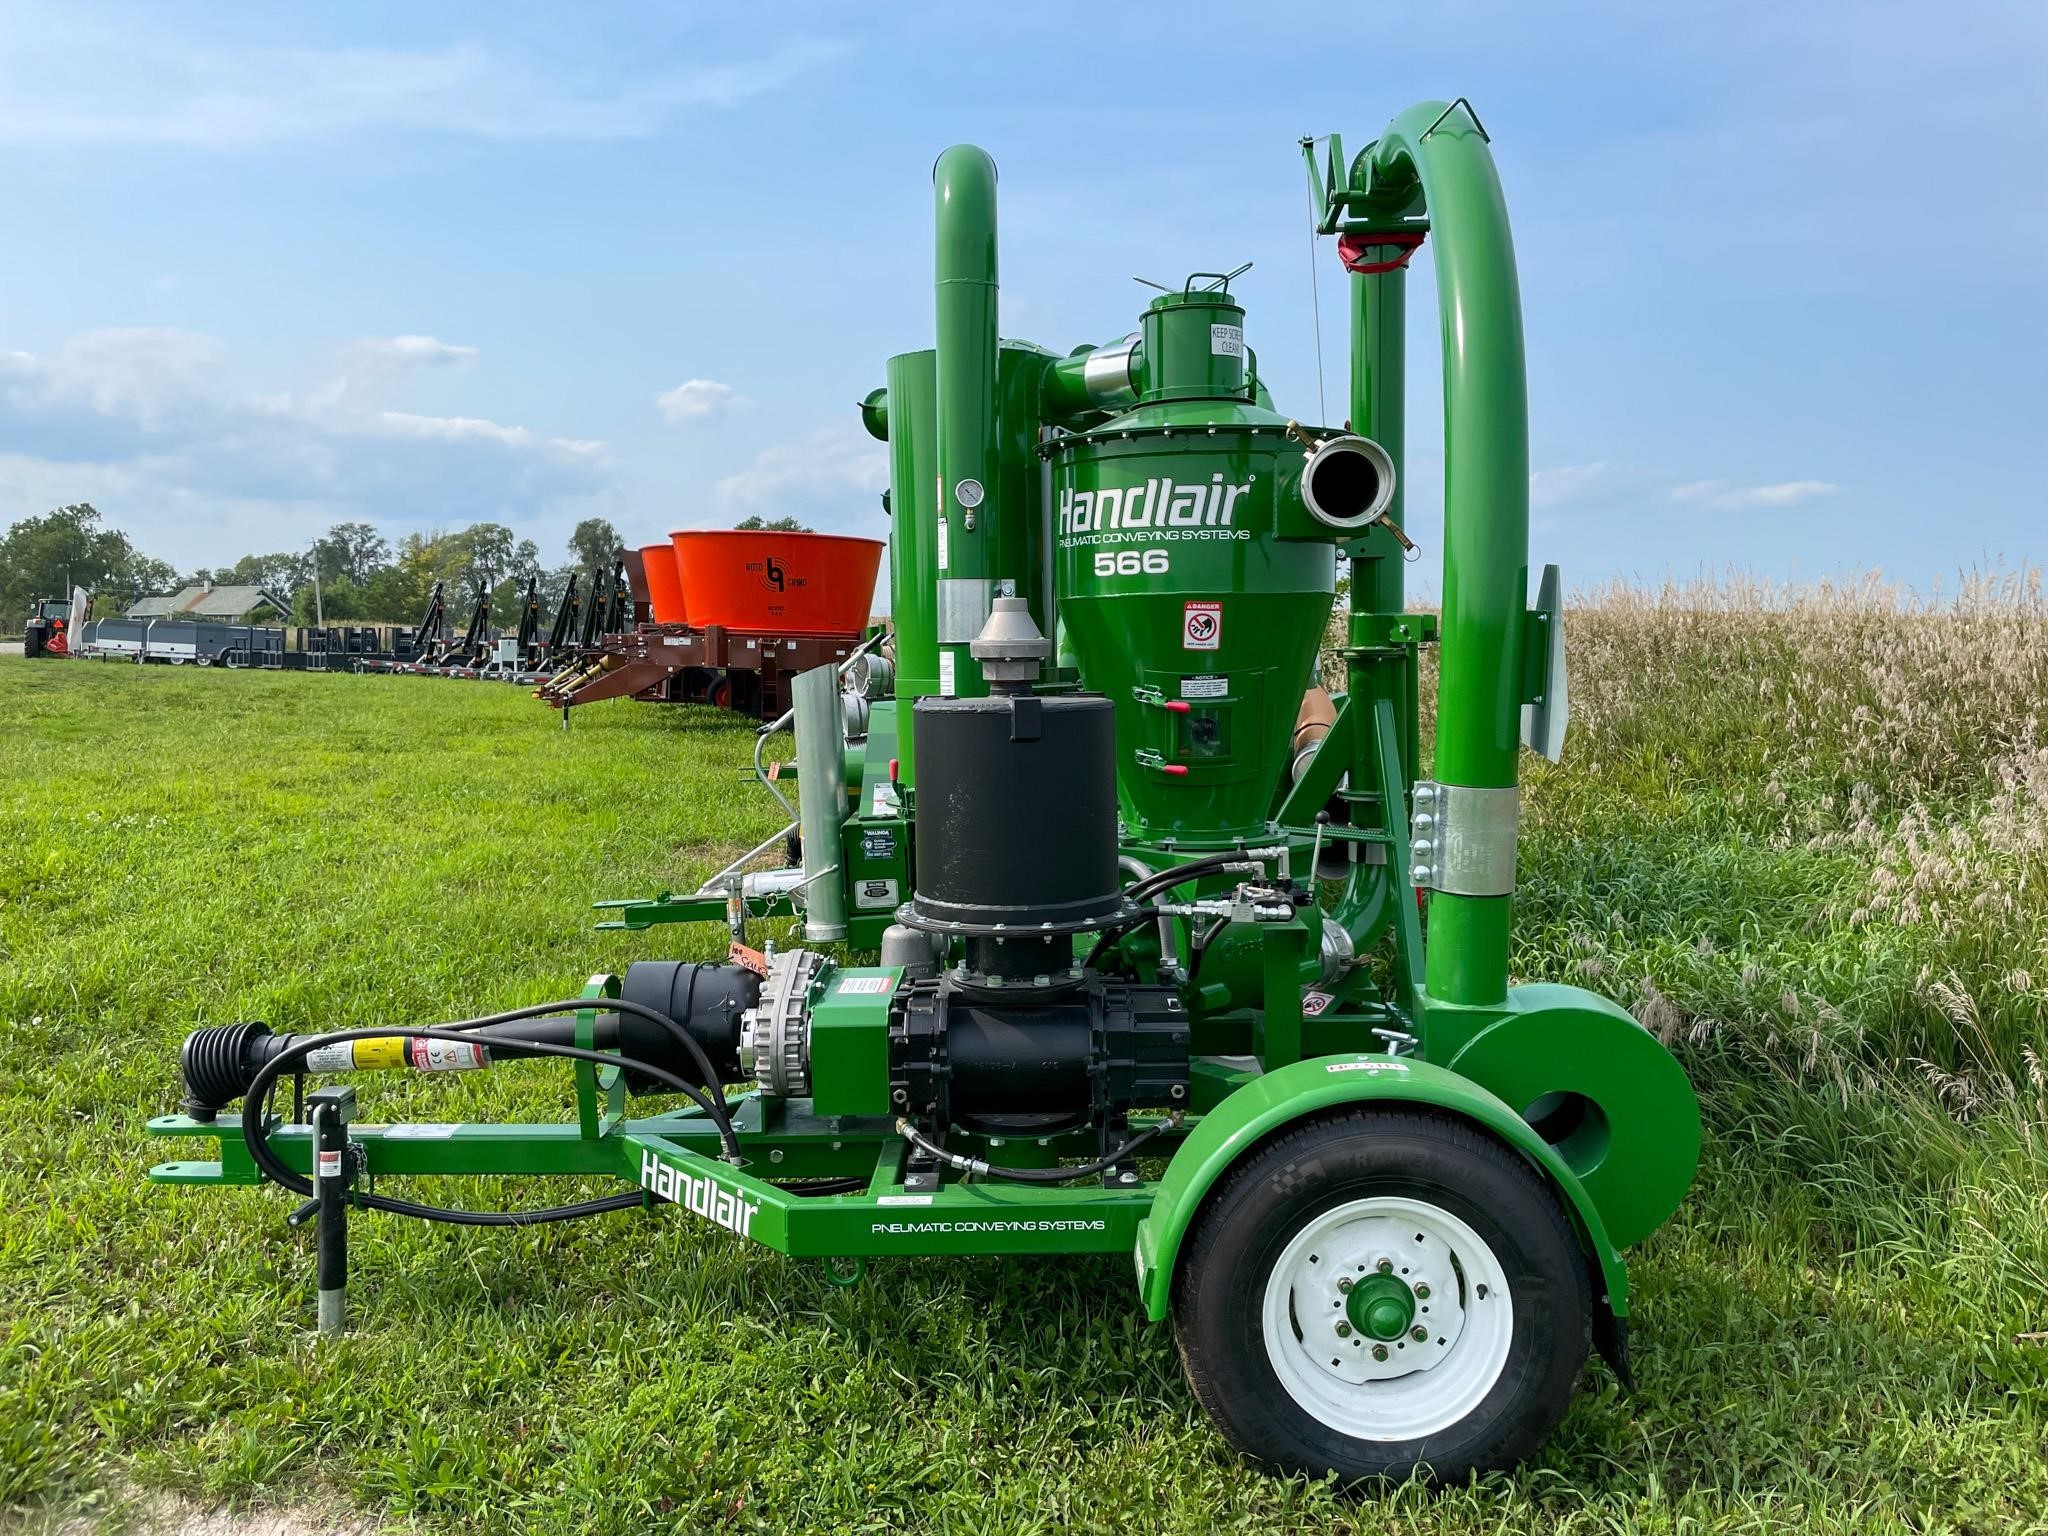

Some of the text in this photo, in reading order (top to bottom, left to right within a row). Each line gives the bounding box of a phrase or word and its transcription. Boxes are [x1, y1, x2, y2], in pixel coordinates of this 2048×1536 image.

[1212, 327, 1242, 341] KEEP SCRE
[1059, 473, 1250, 535] Handlair
[1059, 529, 1250, 548] PNEUMATIC CONVEYING SYSTEMS
[745, 562, 763, 571] ROTO
[1094, 549, 1169, 577] 566
[640, 1148, 758, 1237] Handlair
[871, 1220, 1105, 1233] PNEUMATIC CONVEYING SYSTEMS
